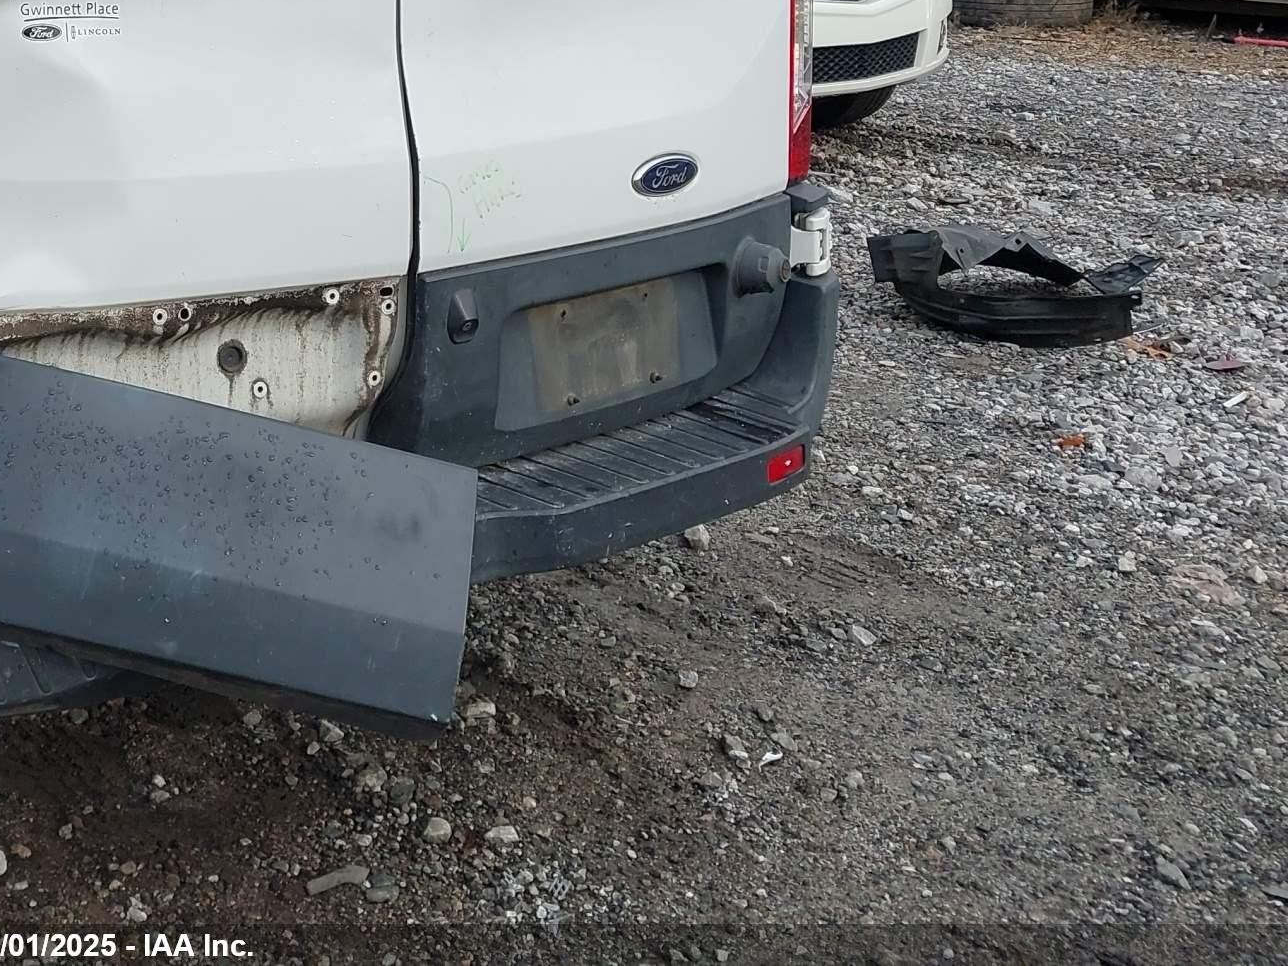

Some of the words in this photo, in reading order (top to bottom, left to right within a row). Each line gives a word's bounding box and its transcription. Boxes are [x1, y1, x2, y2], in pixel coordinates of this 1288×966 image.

[20, 2, 81, 16] Gwinnett
[86, 1, 119, 15] Place
[77, 28, 121, 36] LINCOLN
[652, 164, 688, 189] Ford
